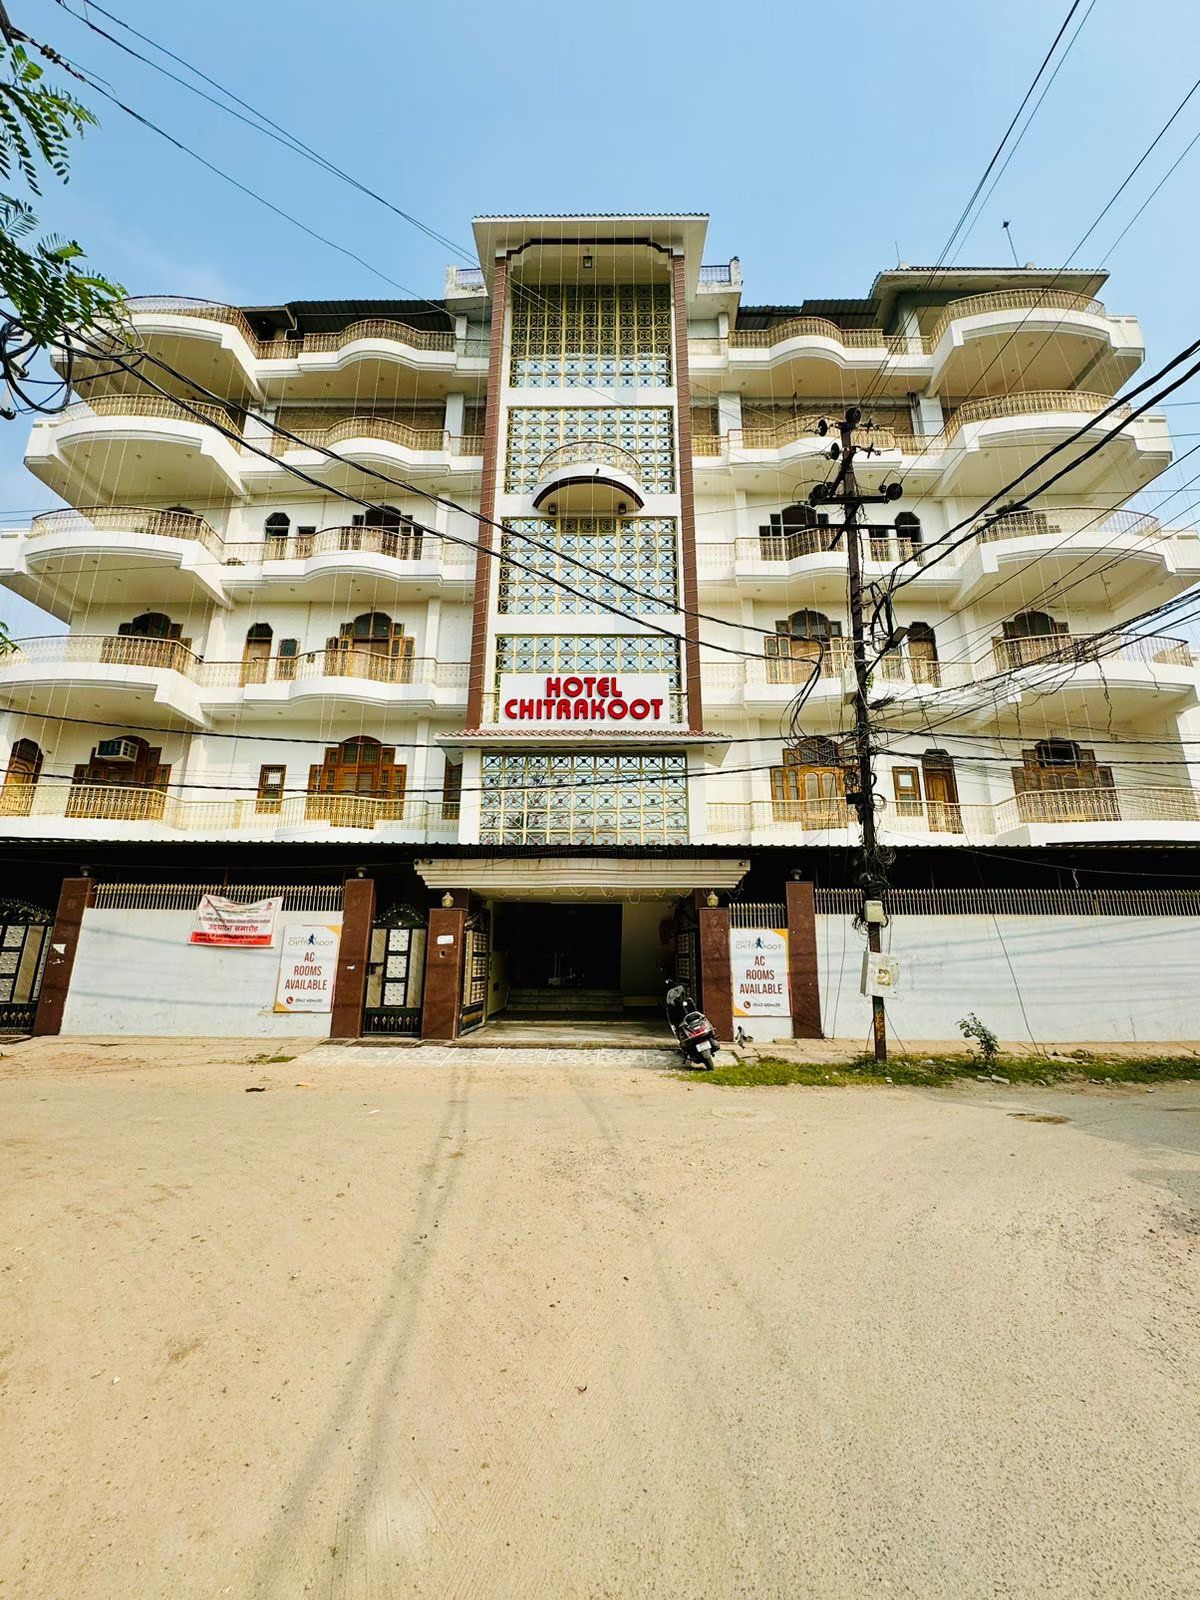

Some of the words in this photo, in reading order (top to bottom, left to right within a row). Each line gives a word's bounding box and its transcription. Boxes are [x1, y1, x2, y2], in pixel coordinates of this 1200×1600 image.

[546, 676, 623, 698] HOTEL
[504, 698, 664, 720] CHITRAKOOT
[304, 951, 315, 962] AC
[754, 955, 765, 966] AC
[293, 965, 322, 976] ROOMS
[745, 969, 775, 980] ROOMS
[284, 979, 328, 990] AVAILABLE
[739, 983, 783, 994] AVAILABLE
